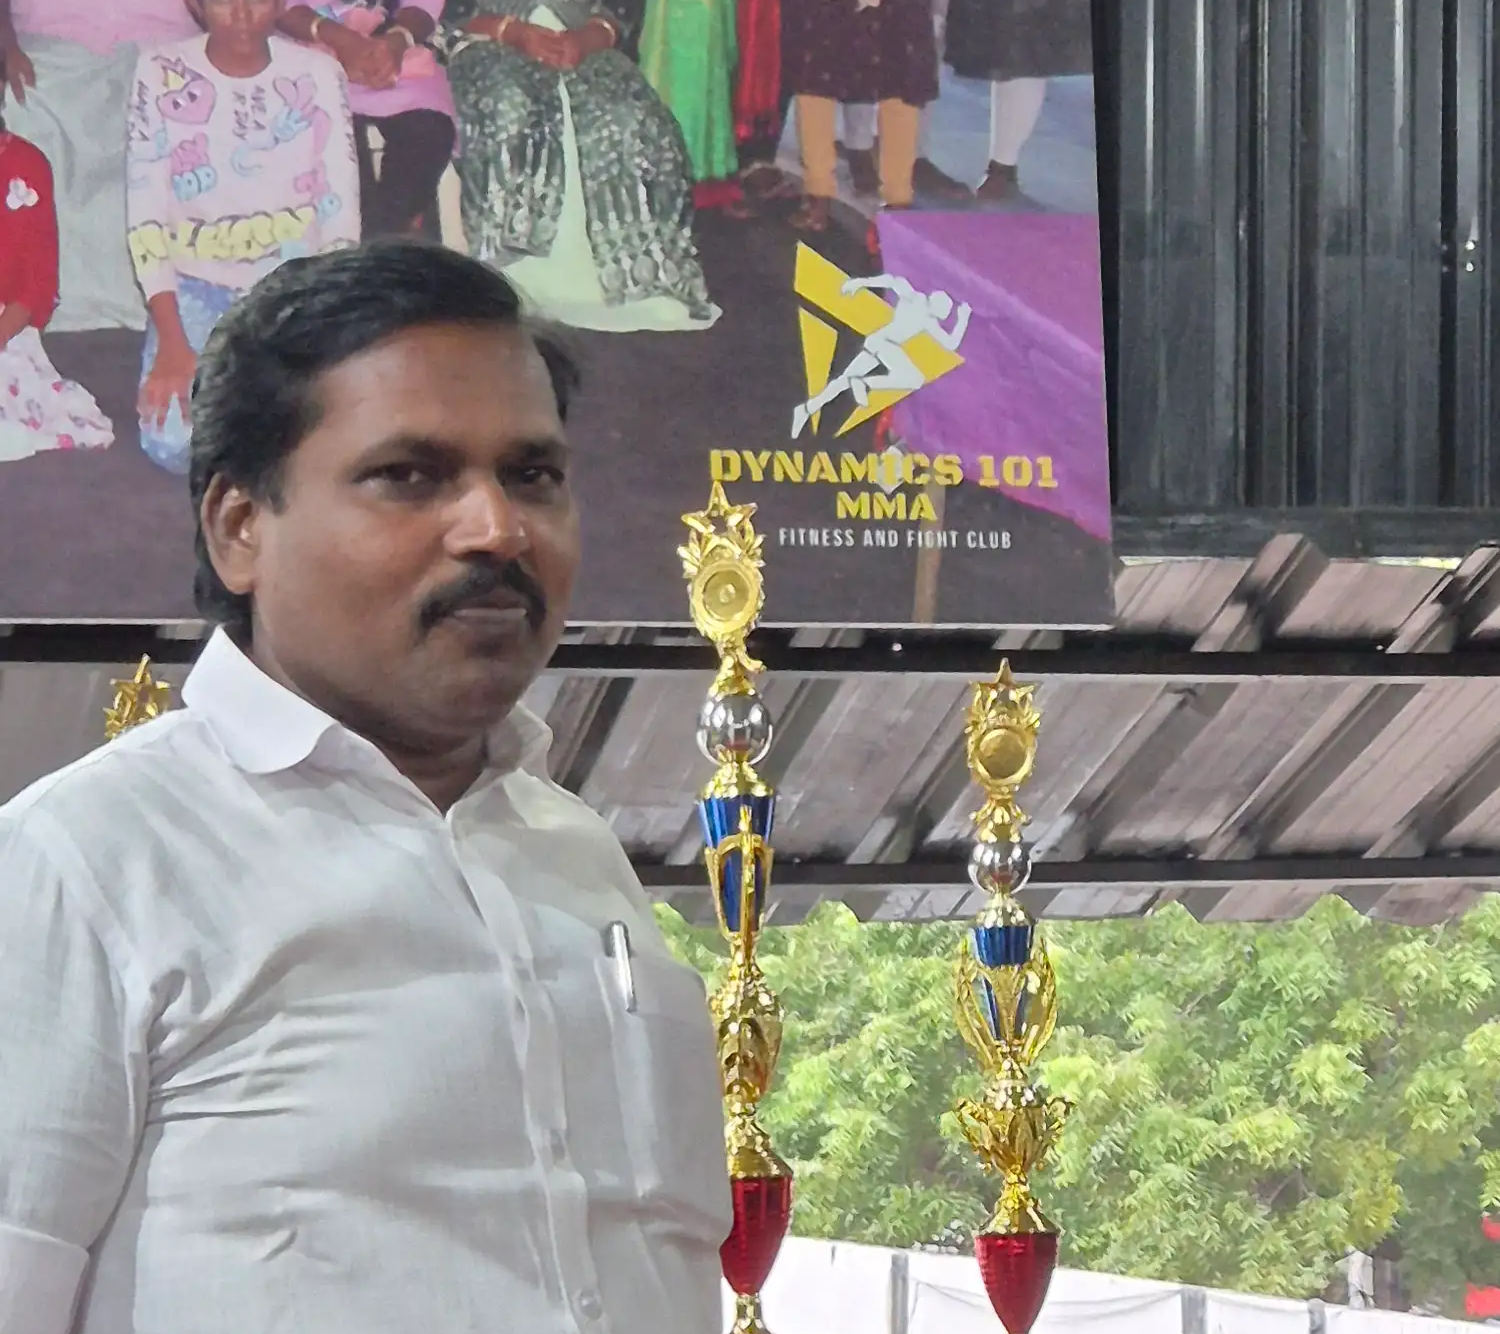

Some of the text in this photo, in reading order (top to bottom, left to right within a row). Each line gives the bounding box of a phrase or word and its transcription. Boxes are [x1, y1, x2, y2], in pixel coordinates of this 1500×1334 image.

[709, 448, 1058, 489] DYNAMICS 101
[836, 491, 938, 522] MMA
[779, 527, 1012, 550] FITNESS AND FIGHT CLUB
